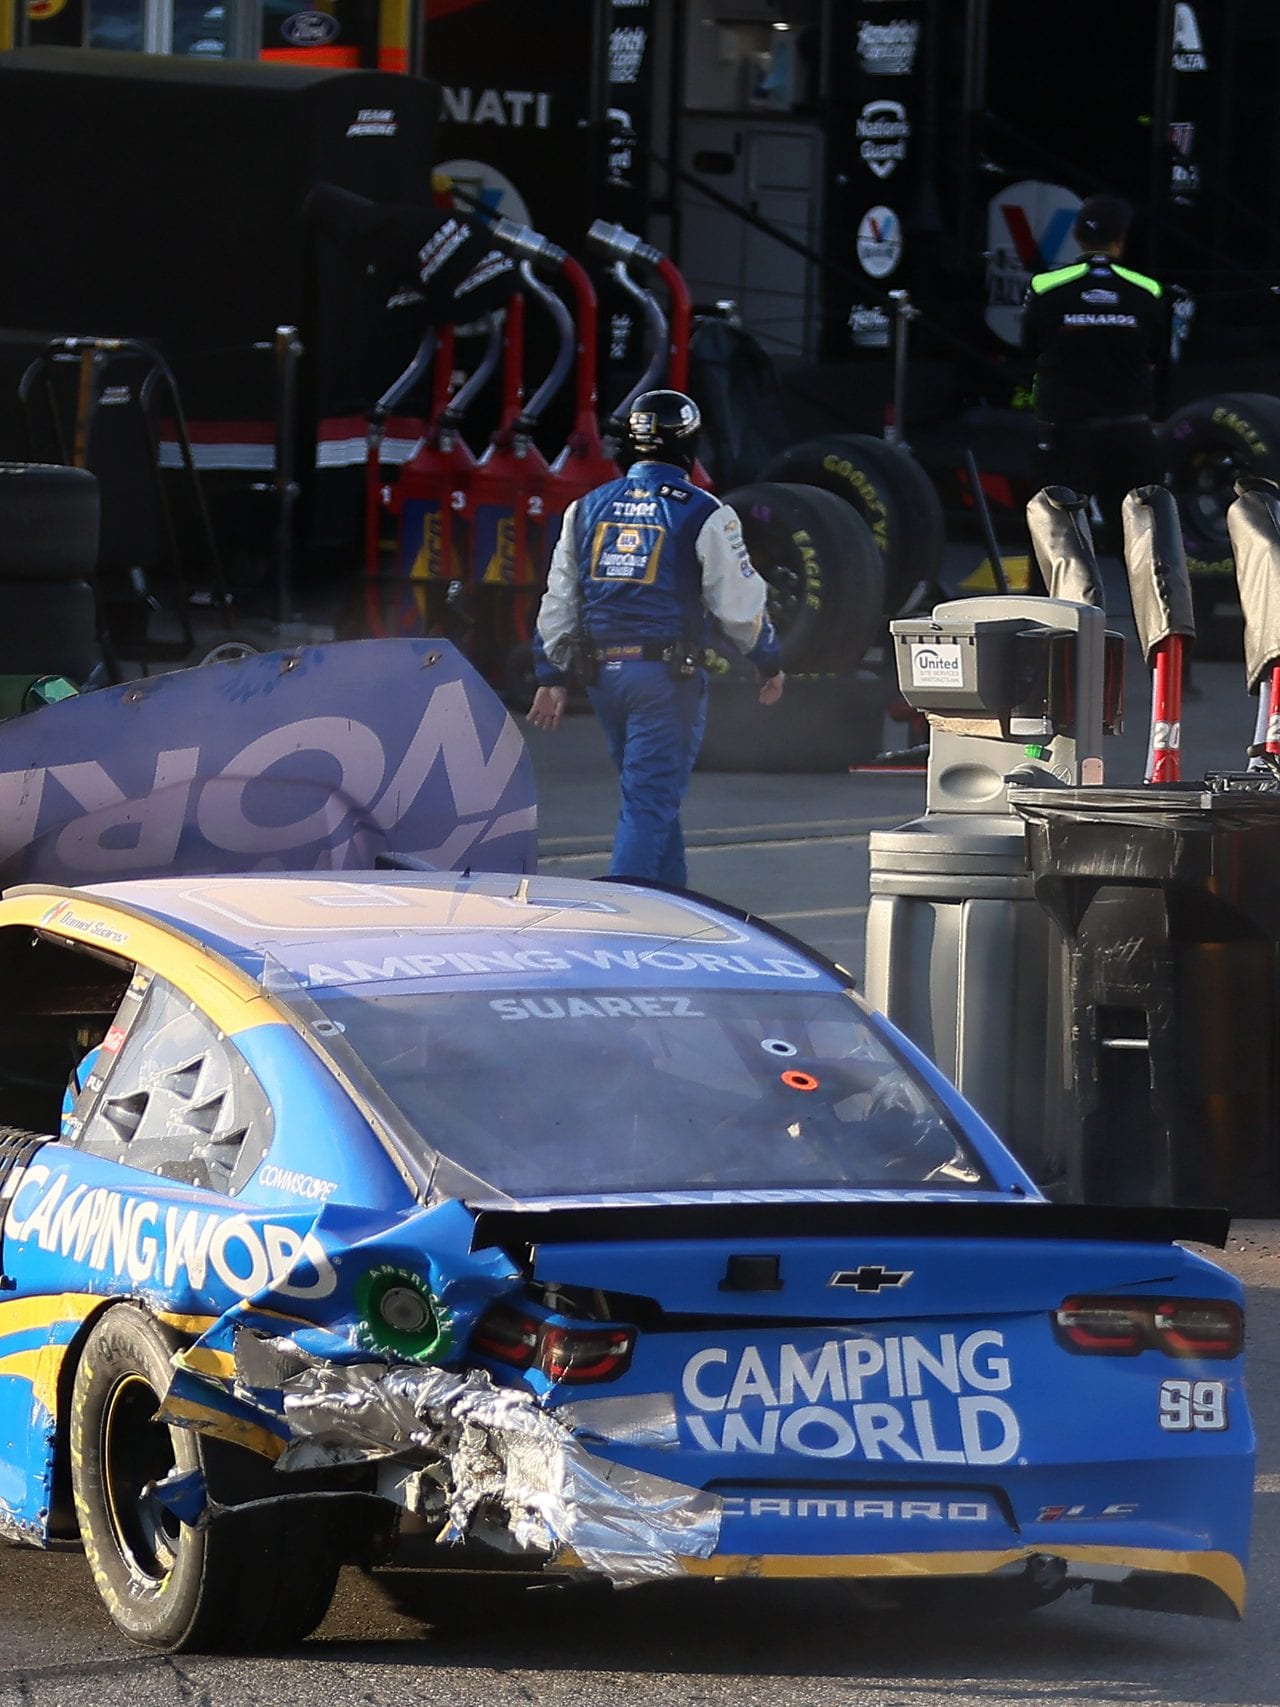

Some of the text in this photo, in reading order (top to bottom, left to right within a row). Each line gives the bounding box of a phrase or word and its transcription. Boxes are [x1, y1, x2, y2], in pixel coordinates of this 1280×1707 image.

[1063, 313, 1137, 328] MENARDS
[450, 490, 466, 510] 3
[527, 496, 544, 515] 2
[612, 501, 658, 517] TIMM
[919, 656, 959, 670] United
[258, 948, 821, 991] CAMPING WORLD
[488, 995, 705, 1023] SUAREZ
[259, 1164, 336, 1200] COMMSCOPE
[4, 1164, 160, 1282] CAMPING
[369, 1264, 453, 1332] AMERICAN
[682, 1329, 1013, 1412] CAMPING
[1158, 1378, 1227, 1432] 99
[683, 1395, 1021, 1467] WORLD
[720, 1497, 988, 1521] CAMARO
